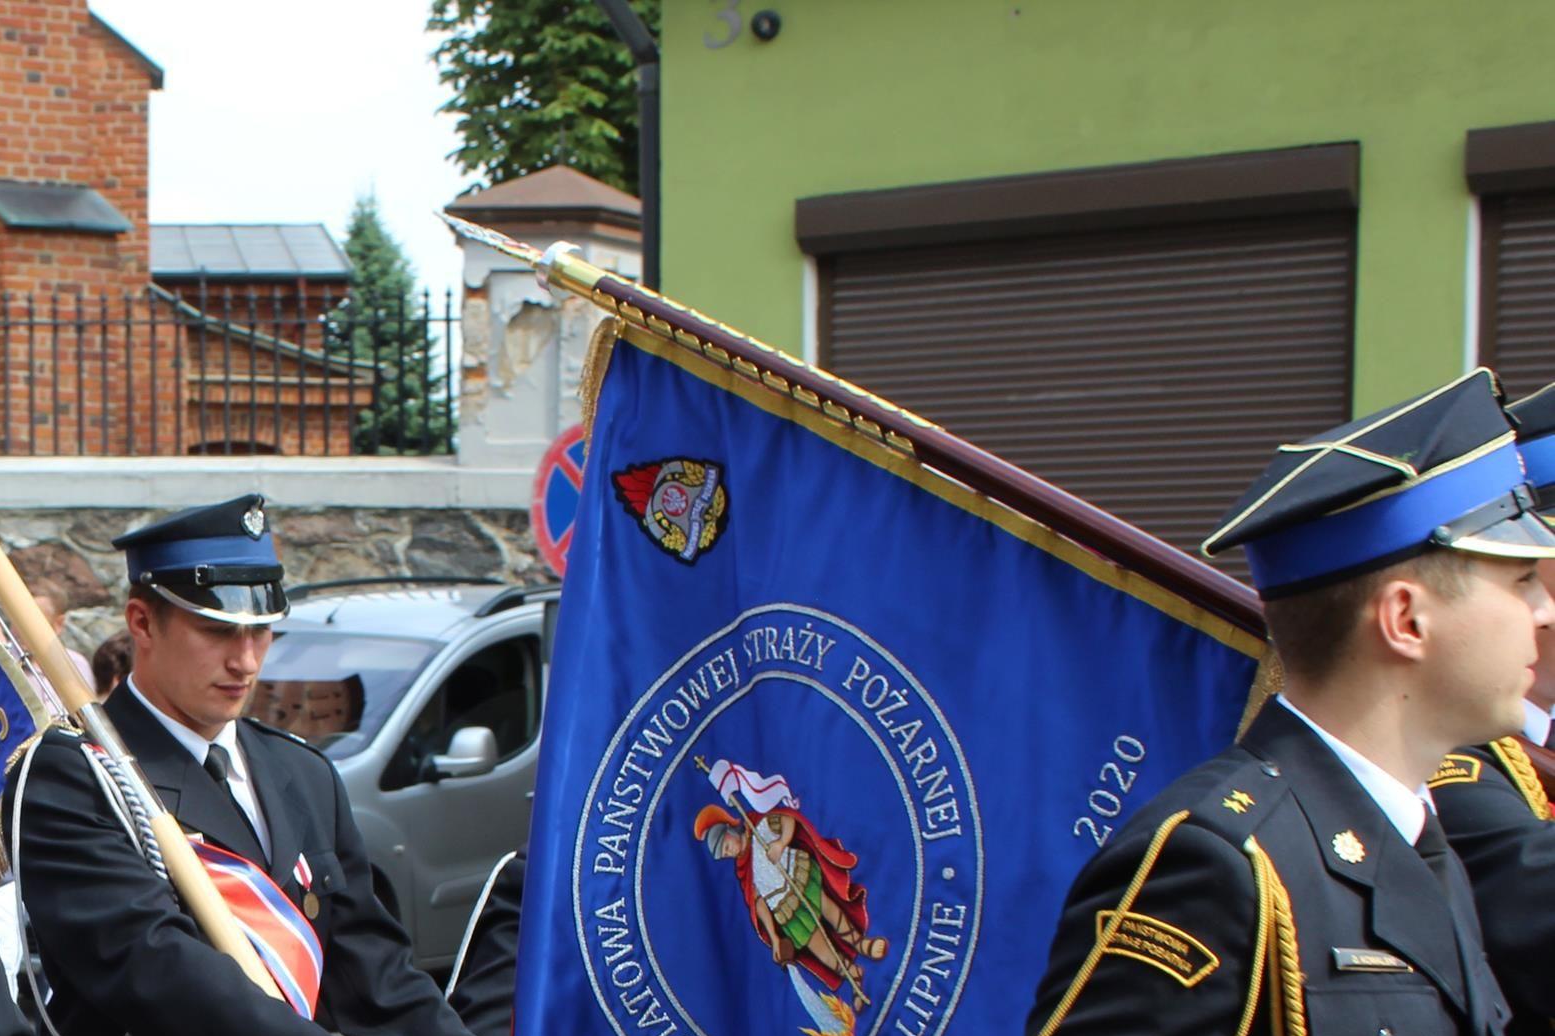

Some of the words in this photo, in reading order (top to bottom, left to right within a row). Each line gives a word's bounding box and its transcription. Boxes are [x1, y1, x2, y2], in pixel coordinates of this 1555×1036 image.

[594, 647, 740, 876] PAŃSTWOWEJ
[743, 622, 837, 672] STRAŻY
[841, 656, 962, 841] POŻARNEJ
[1073, 735, 1146, 848] 2020
